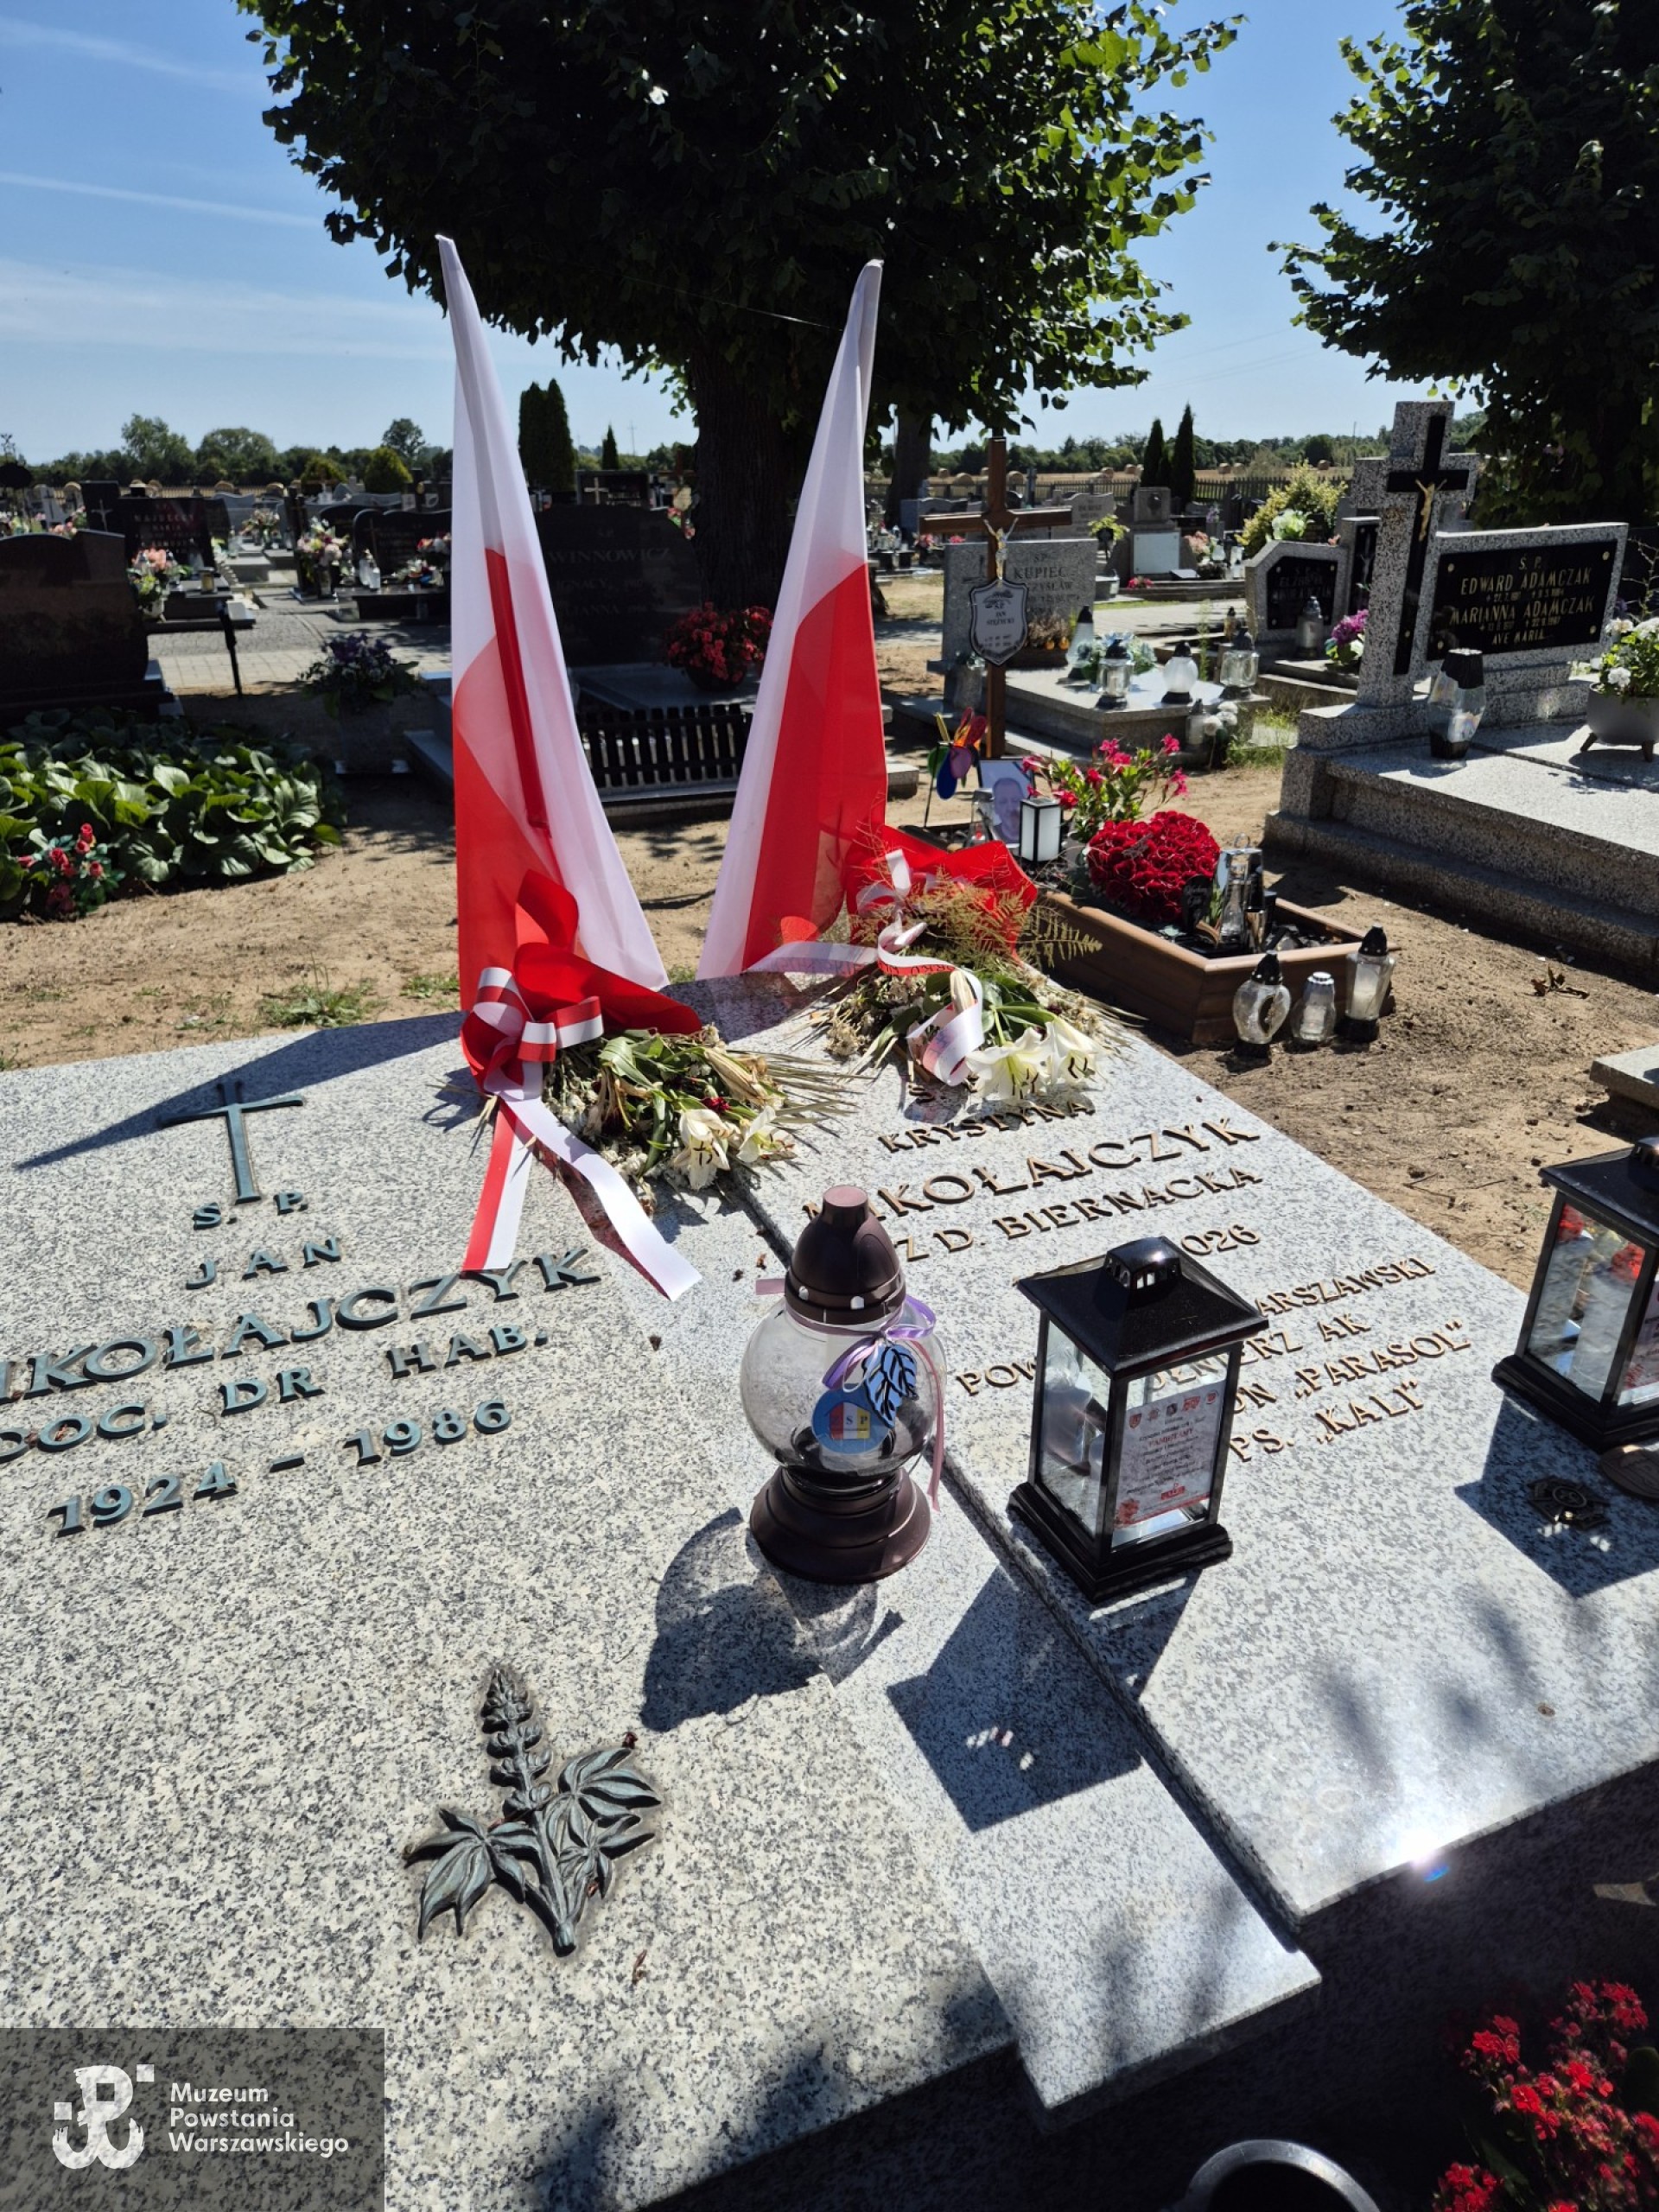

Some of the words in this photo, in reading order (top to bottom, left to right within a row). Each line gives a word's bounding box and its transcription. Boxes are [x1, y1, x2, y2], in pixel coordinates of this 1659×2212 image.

[1014, 566, 1067, 578] KUPIEC
[1460, 574, 1513, 595] EDWARD
[1521, 567, 1592, 589] ADAMCZAK
[1449, 604, 1516, 626] MARIANNA
[1523, 595, 1595, 619] ADAMCZAK
[1492, 632, 1510, 645] AVE
[878, 1102, 1096, 1153] KRYSTYNA
[802, 1117, 1261, 1221] KOŁAJCZYK
[273, 1191, 308, 1216] P.
[992, 1166, 1263, 1241] BIERNACKA
[1180, 1224, 1261, 1255] 026
[186, 1235, 341, 1290] JAN
[1254, 1257, 1436, 1317] ARSZAWSKI
[1317, 1313, 1372, 1342] AK
[219, 1366, 324, 1416] DR
[387, 1324, 549, 1380] HAB.
[1230, 1429, 1294, 1463] PS.
[48, 1462, 238, 1539] 1924
[346, 1400, 511, 1466] 1986
